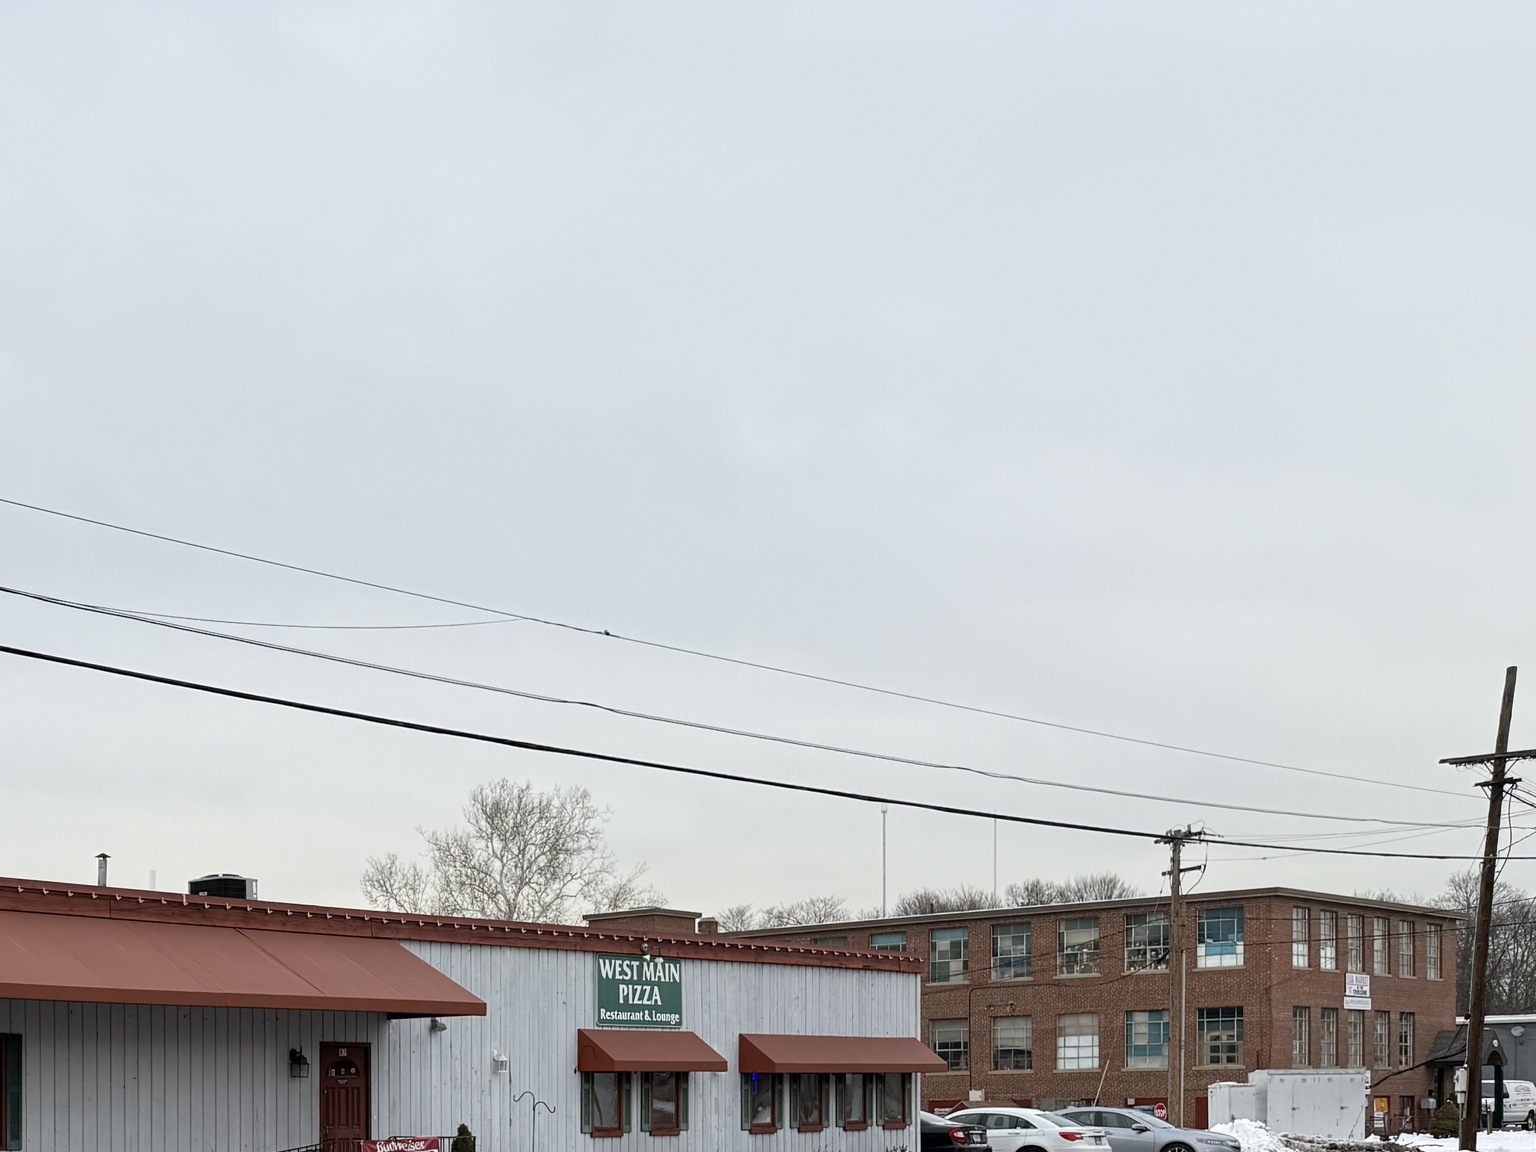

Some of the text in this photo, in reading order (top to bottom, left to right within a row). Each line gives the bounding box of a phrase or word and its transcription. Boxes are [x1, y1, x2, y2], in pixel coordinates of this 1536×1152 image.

[599, 959, 680, 983] WEST MAIN
[619, 984, 662, 1005] PIZZA
[600, 1008, 680, 1024] Restaurant & Lounge
